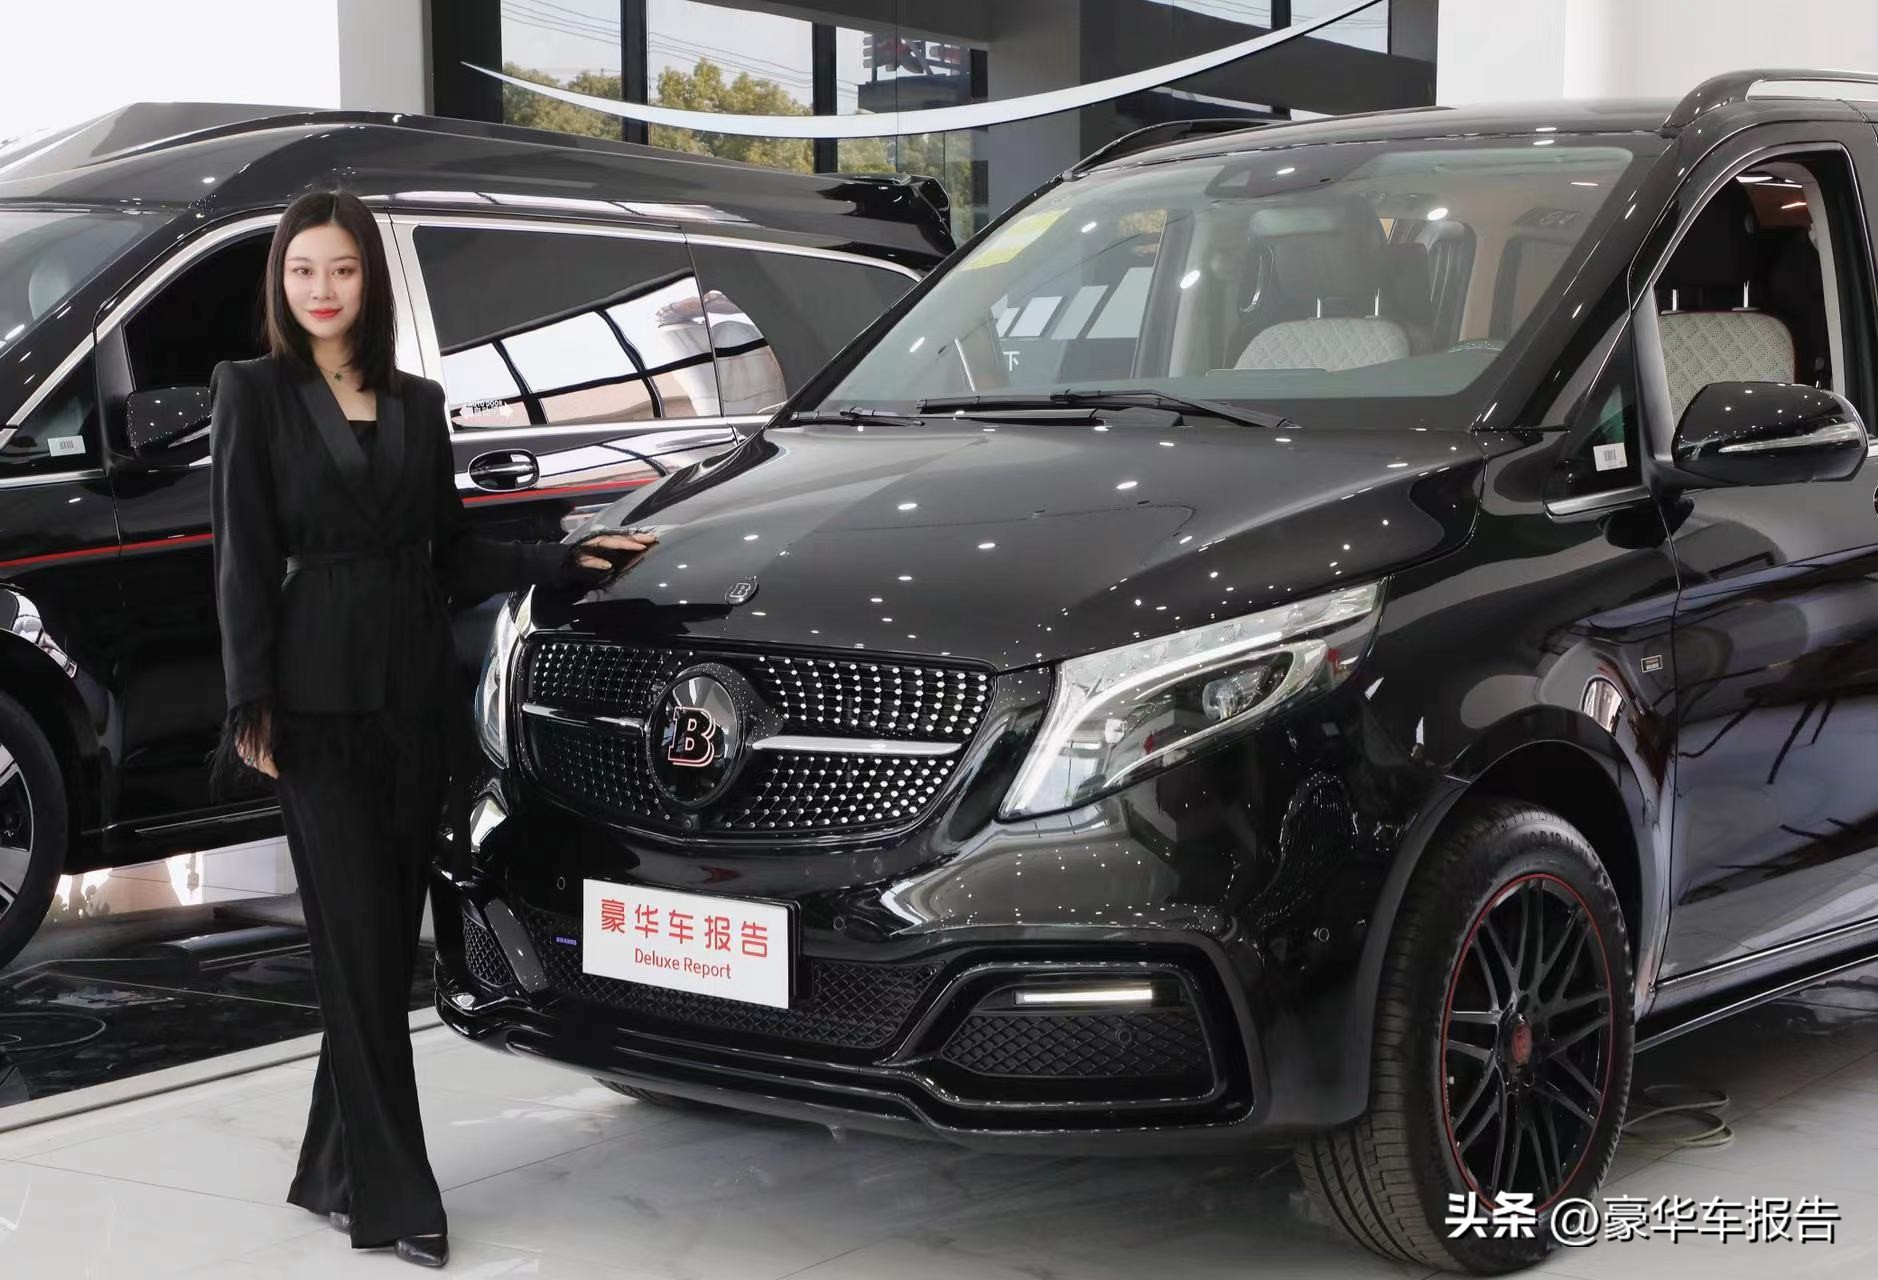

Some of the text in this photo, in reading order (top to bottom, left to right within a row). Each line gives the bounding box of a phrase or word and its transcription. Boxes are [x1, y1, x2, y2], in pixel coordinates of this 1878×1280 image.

[600, 899, 768, 958] 豪华车报告
[634, 947, 732, 980] Deluxe Report
